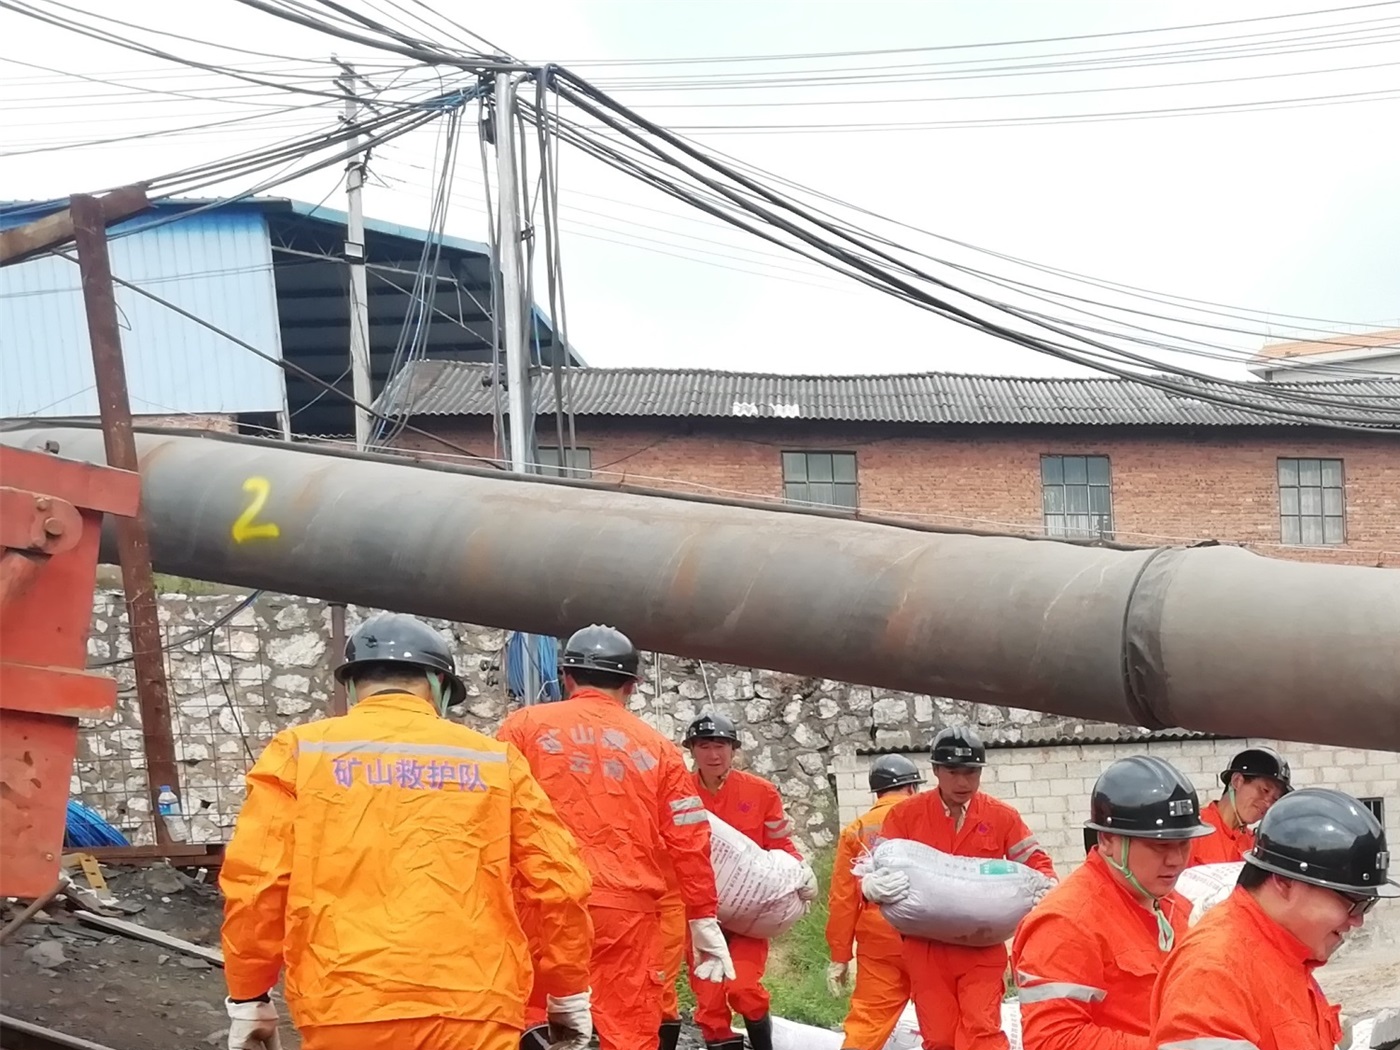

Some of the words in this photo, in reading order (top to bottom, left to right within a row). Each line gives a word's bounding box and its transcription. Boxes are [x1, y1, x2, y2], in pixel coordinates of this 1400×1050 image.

[231, 476, 280, 544] 2
[331, 757, 489, 792] 矿山救护队
